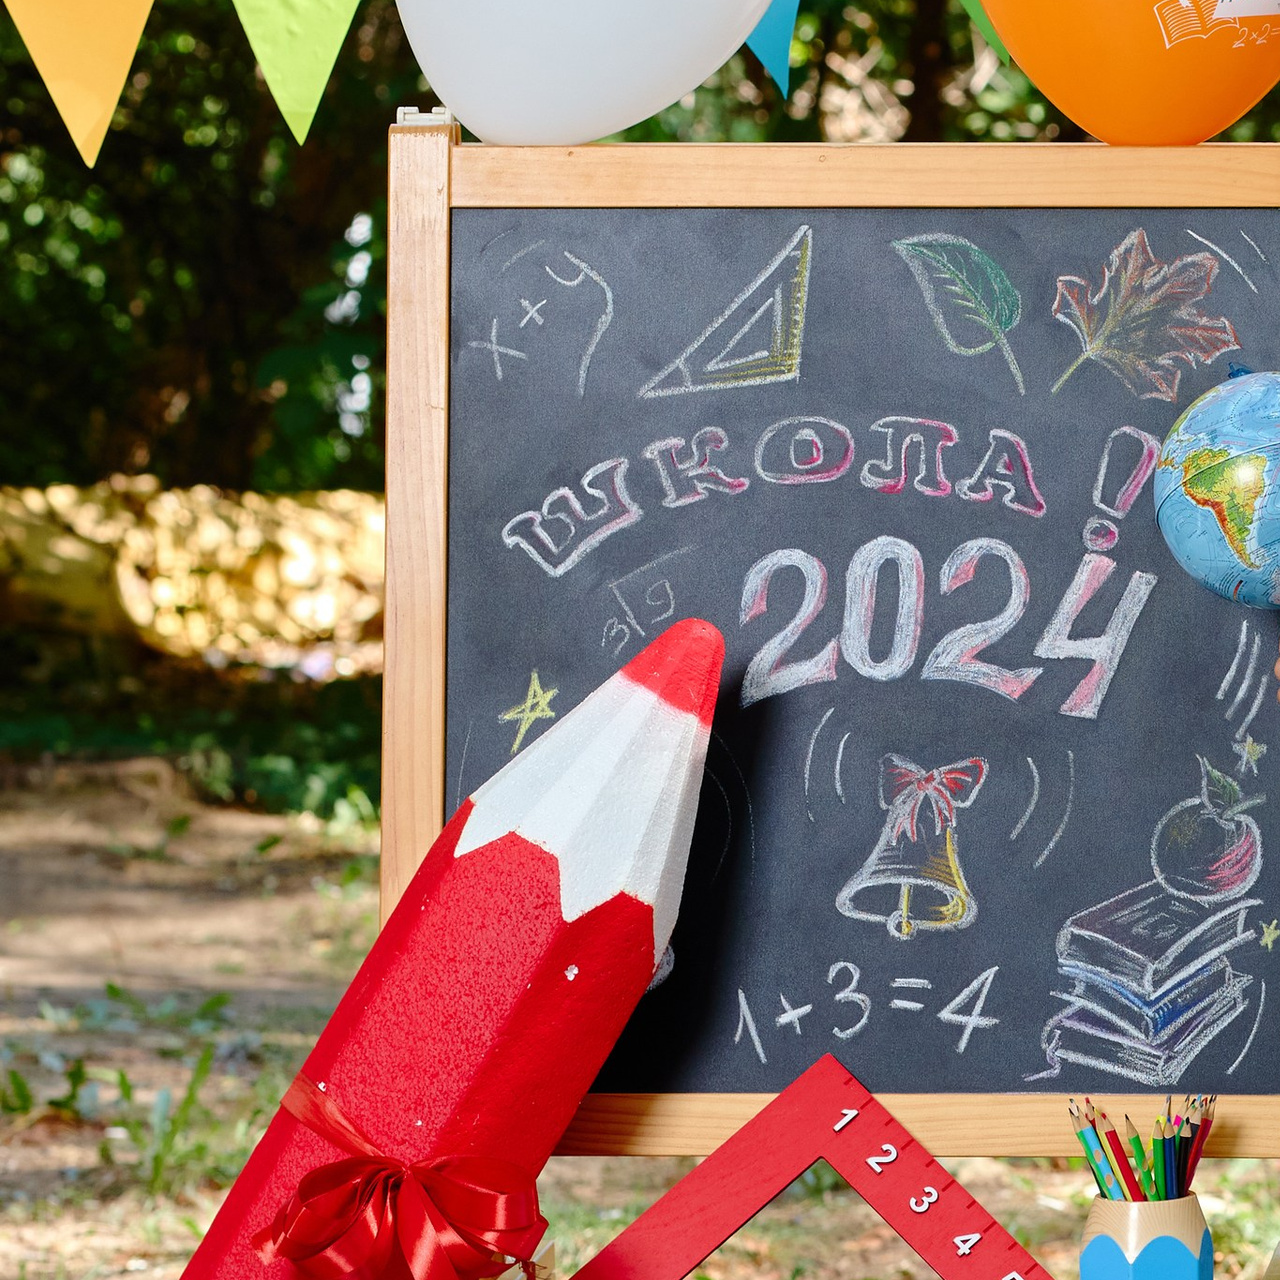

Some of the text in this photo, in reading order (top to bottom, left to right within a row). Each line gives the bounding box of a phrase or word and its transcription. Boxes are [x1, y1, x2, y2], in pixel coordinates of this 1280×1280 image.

[501, 415, 1162, 578] ШКОЛА!
[738, 534, 1159, 721] 2024
[833, 1109, 859, 1132] 1
[865, 1144, 899, 1174] 2
[909, 1186, 938, 1213] 3
[953, 1232, 982, 1257] 4
